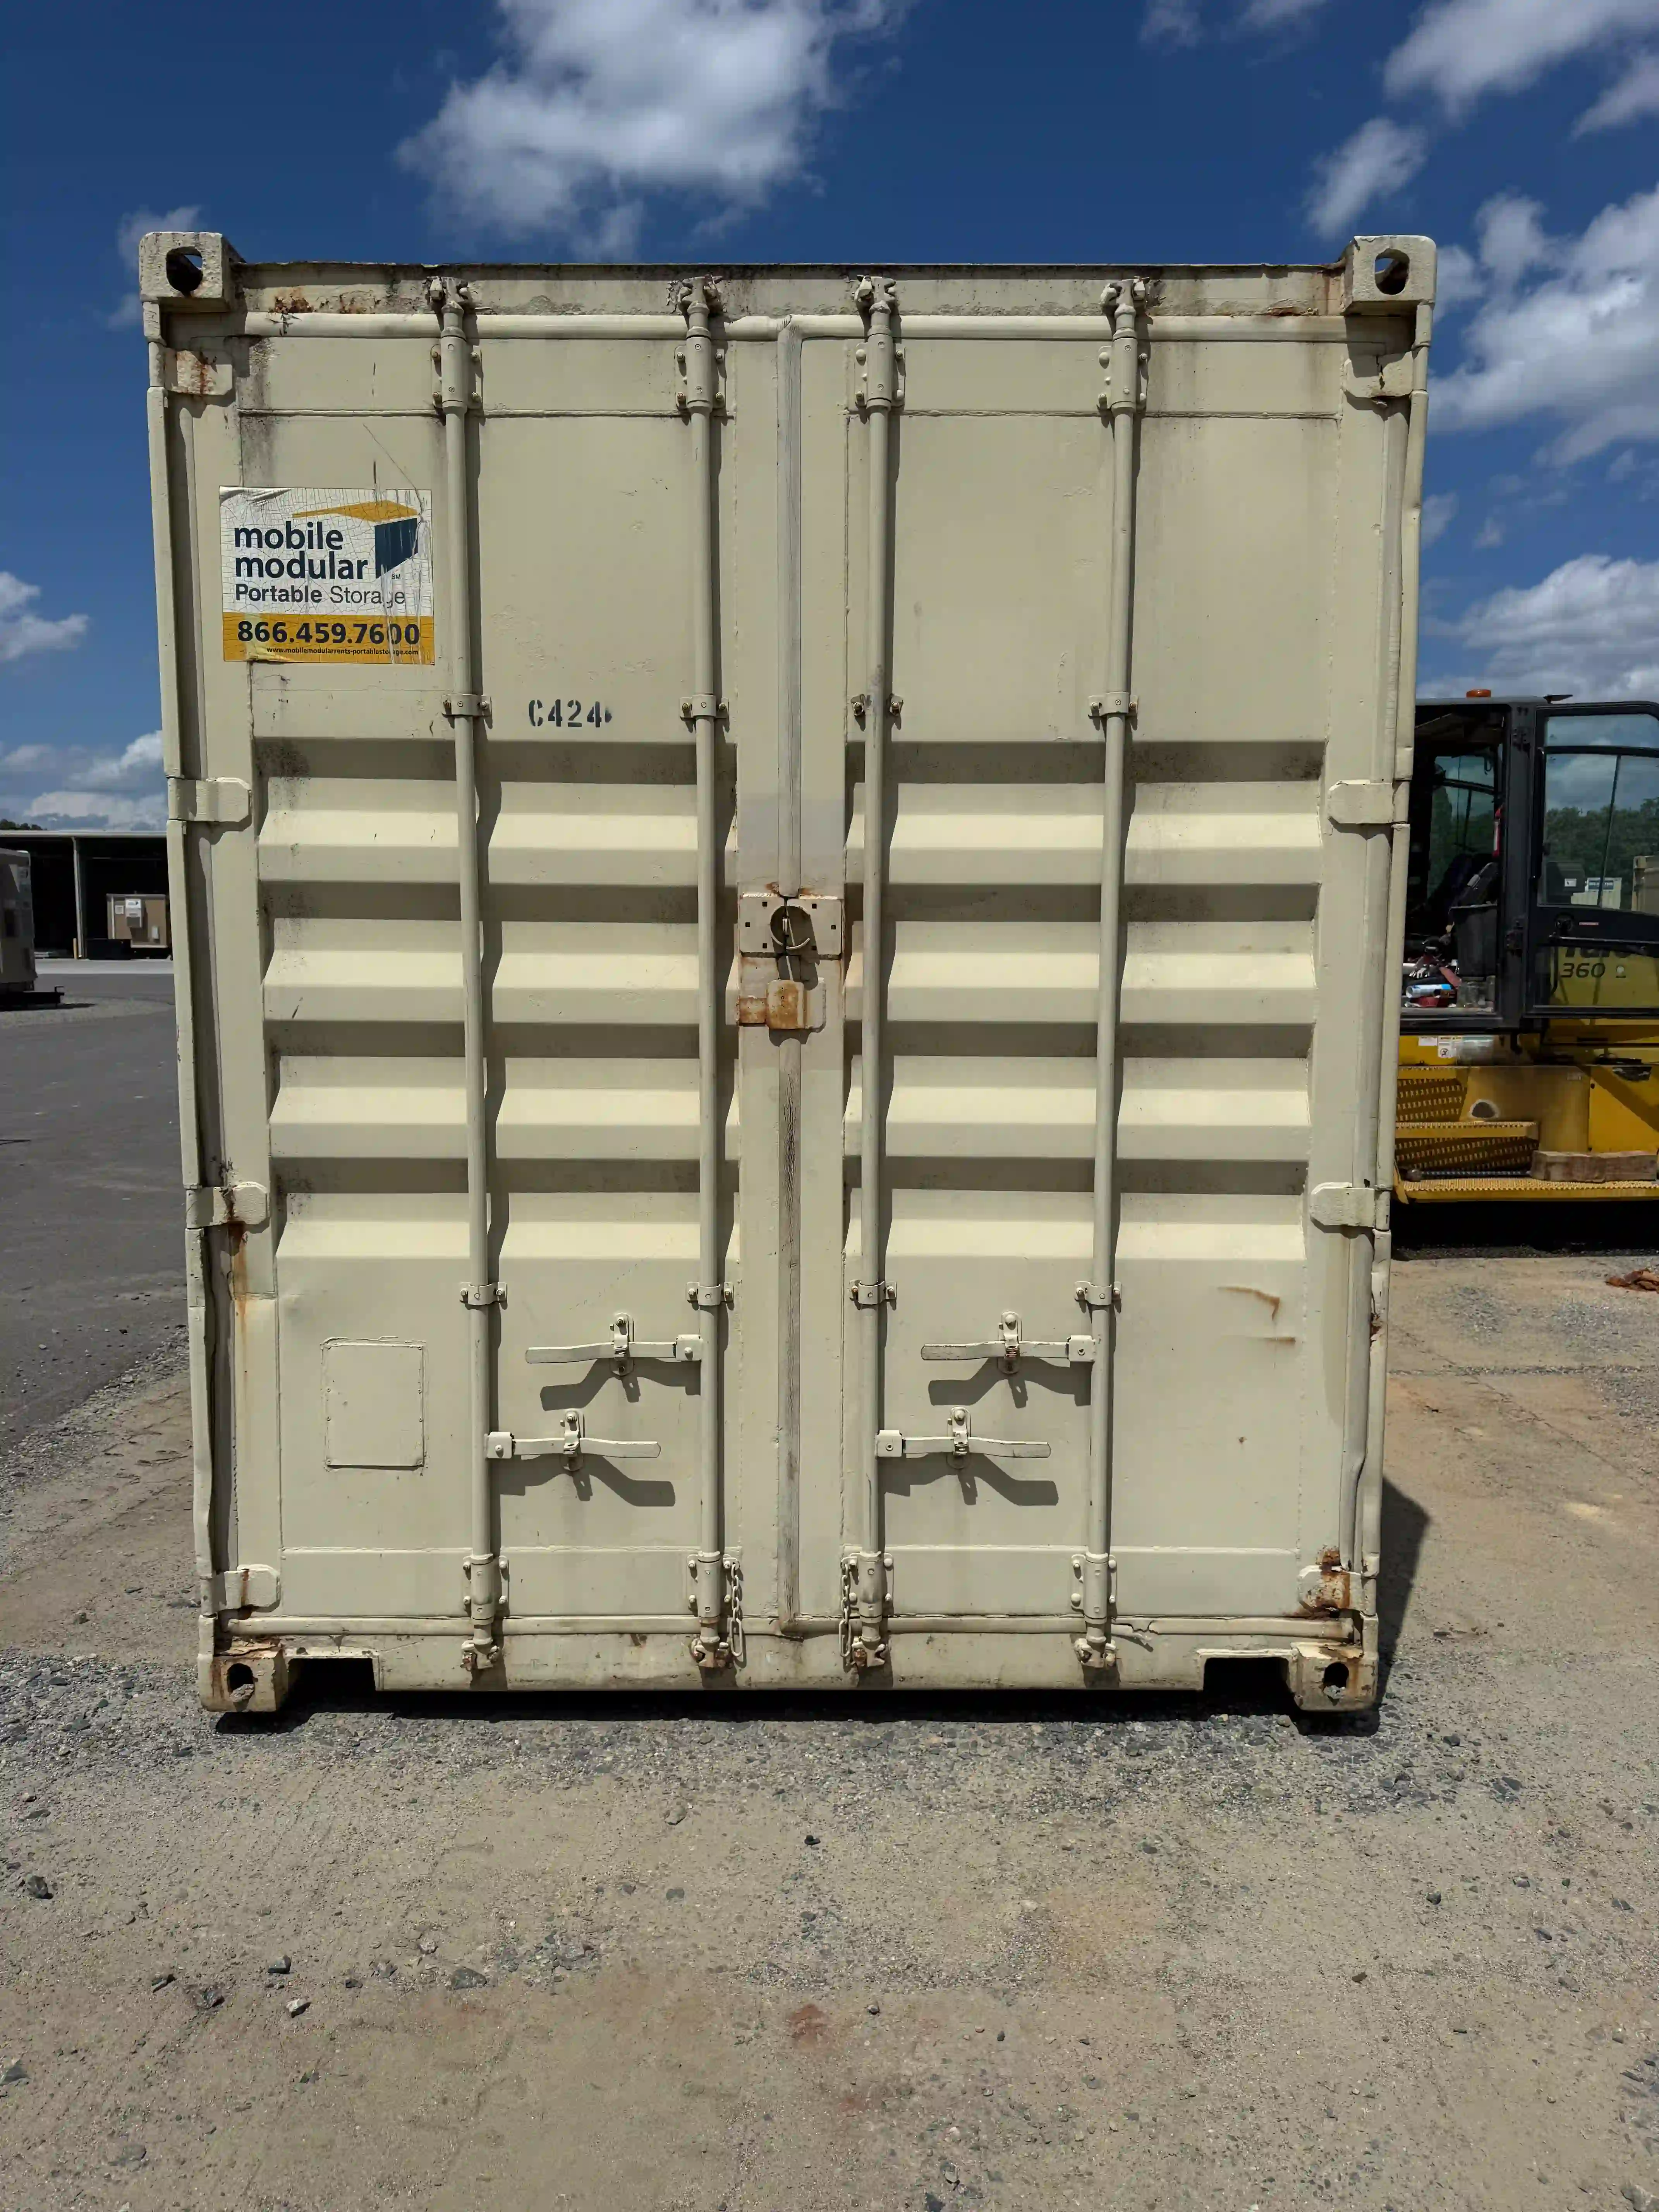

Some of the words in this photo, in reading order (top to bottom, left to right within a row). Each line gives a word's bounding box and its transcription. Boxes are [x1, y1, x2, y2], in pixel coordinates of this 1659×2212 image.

[234, 521, 343, 550] mobile
[235, 550, 368, 580] modular
[236, 583, 322, 603] Portable
[237, 621, 420, 644] 866.459.7600
[266, 647, 419, 656] www.mobilemodularrents-portablestoage.com
[1560, 962, 1606, 978] 360
